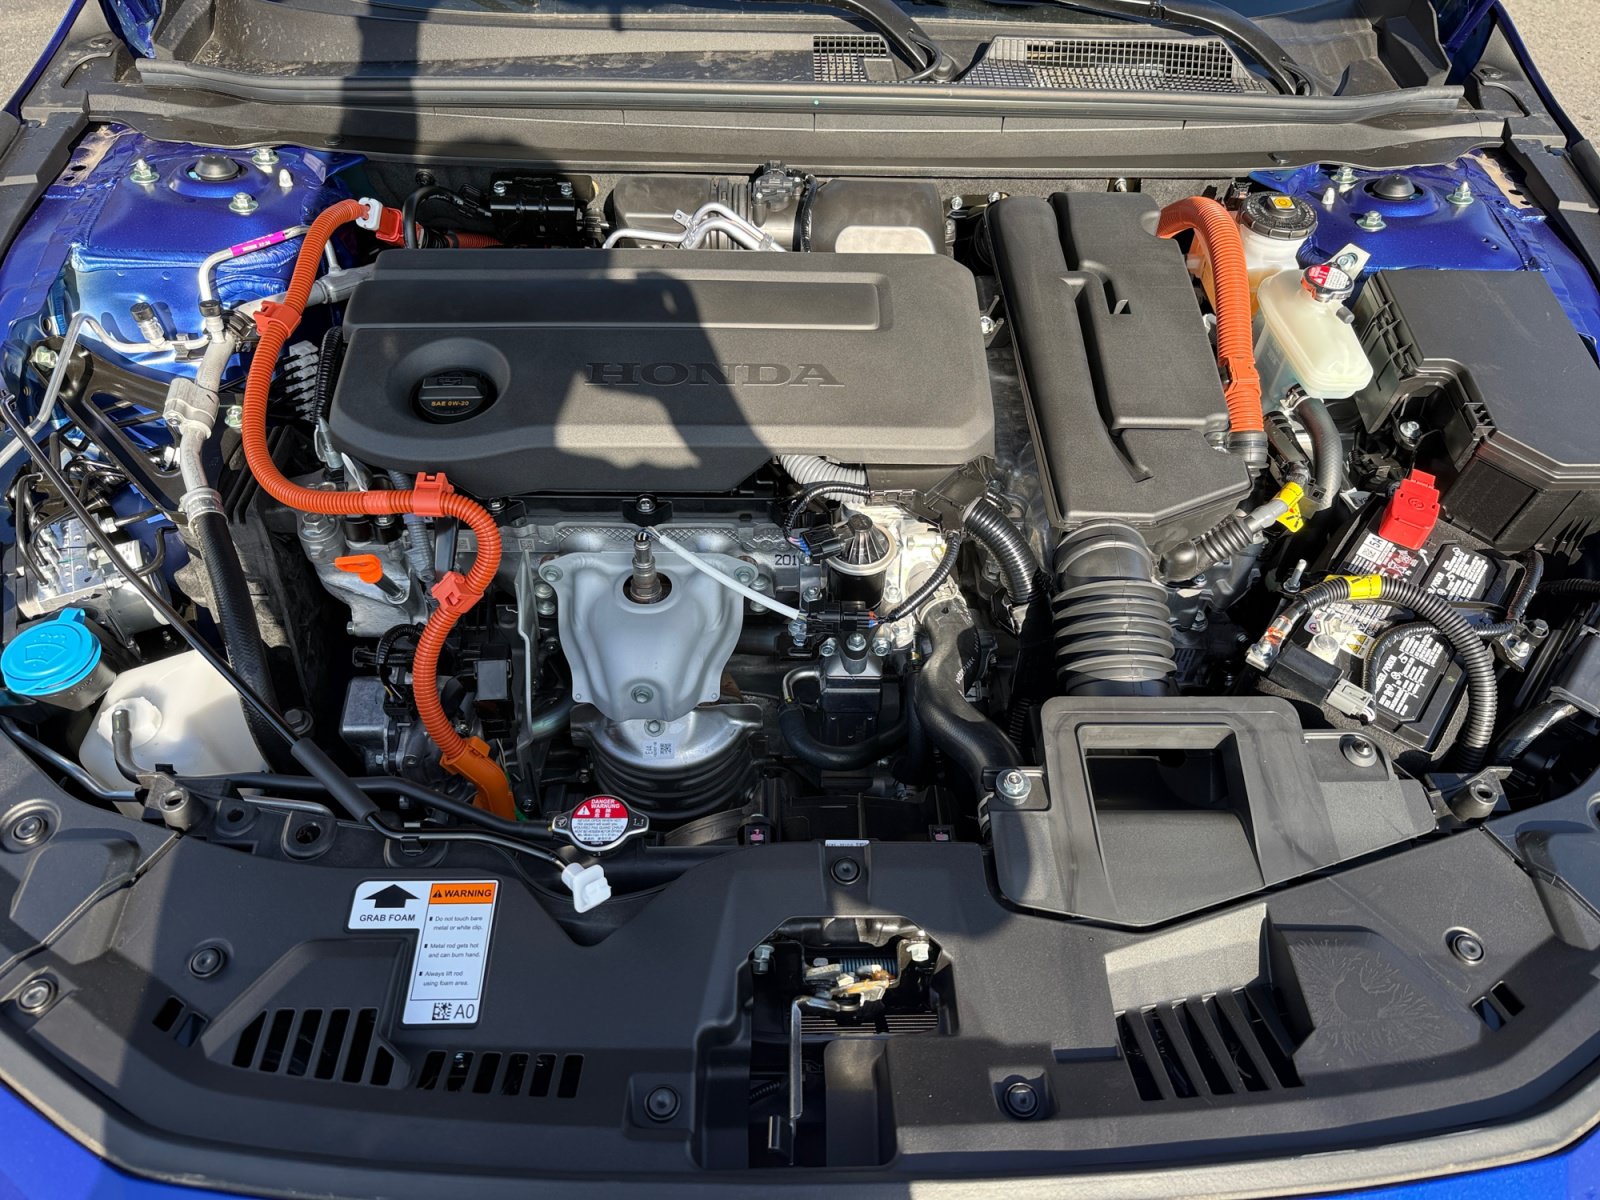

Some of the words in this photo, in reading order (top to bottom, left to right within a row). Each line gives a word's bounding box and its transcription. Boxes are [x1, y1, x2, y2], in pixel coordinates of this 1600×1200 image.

[584, 362, 845, 387] HONDA
[774, 554, 797, 566] 201
[444, 889, 492, 898] WARNING
[359, 914, 387, 922] GRAB
[388, 914, 416, 922] FOAM
[453, 1003, 475, 1019] A0
